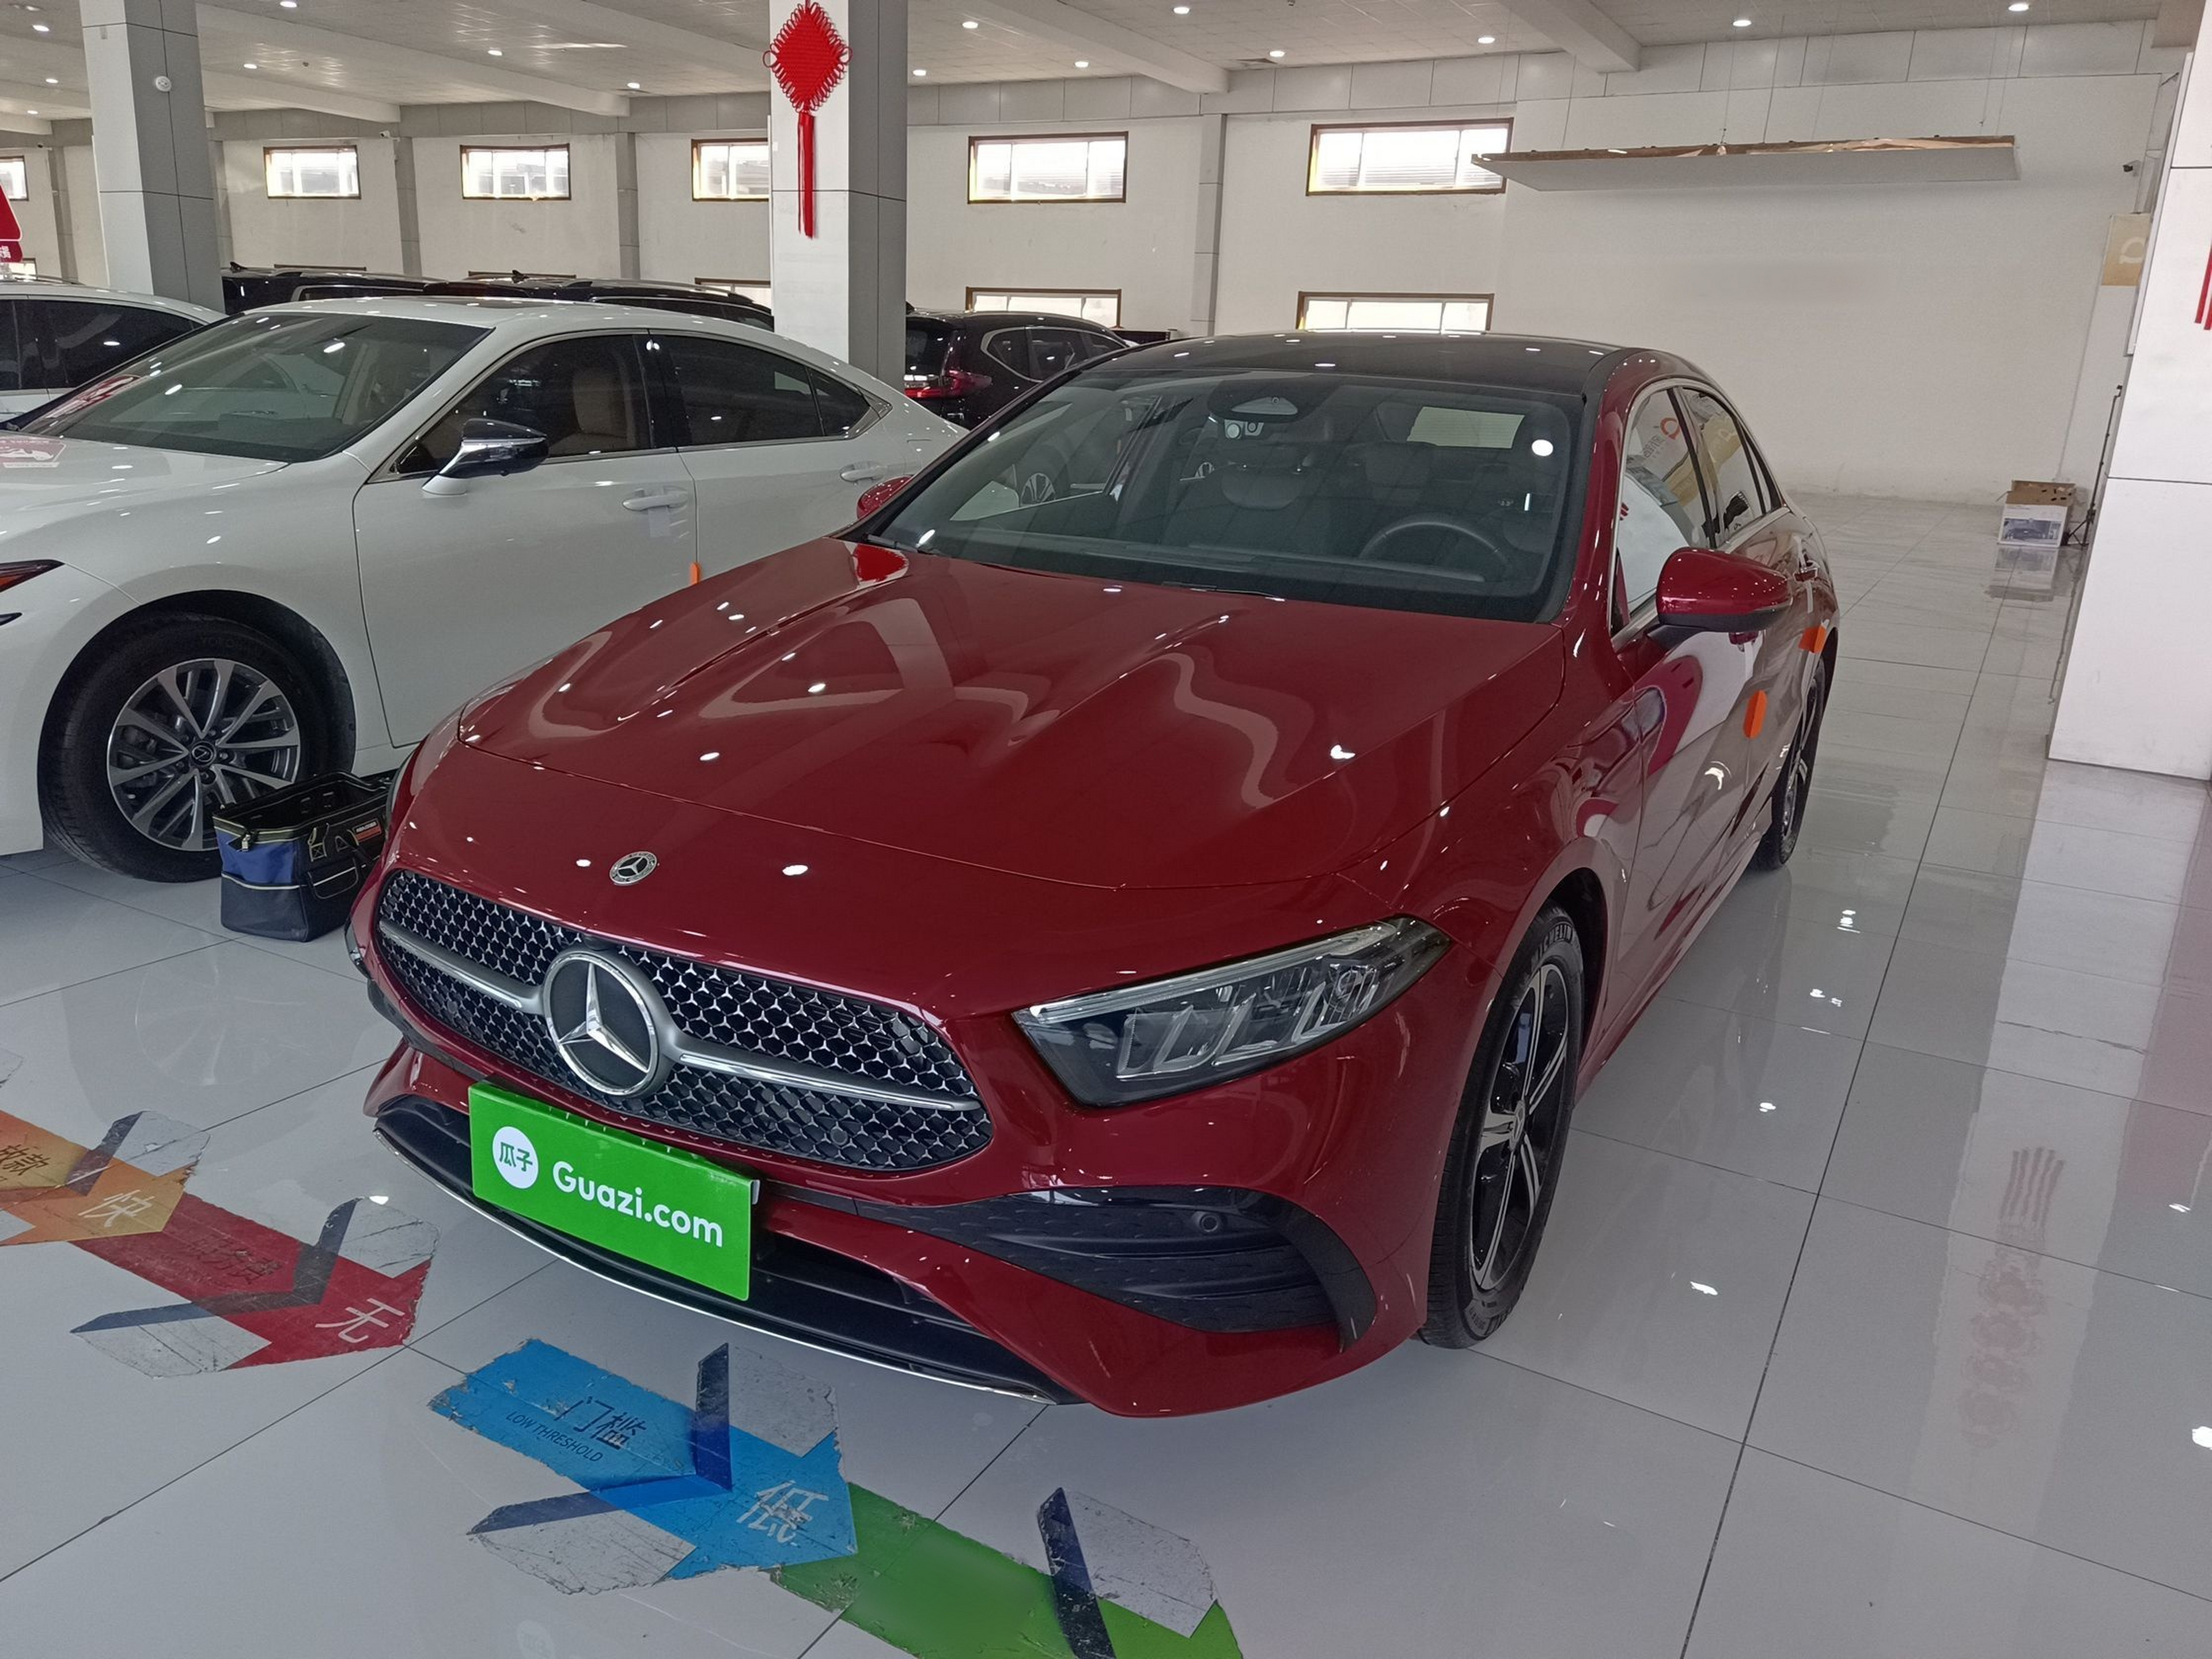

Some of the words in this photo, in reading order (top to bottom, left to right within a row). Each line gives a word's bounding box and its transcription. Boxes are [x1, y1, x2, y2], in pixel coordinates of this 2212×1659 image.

[499, 1141, 533, 1172] 瓜子
[78, 1189, 155, 1228] 快
[552, 1161, 723, 1248] Guazi.com
[315, 1298, 404, 1343] 无
[505, 1410, 537, 1429] LOW
[535, 1422, 604, 1462] THRESHOLD
[554, 1396, 647, 1450] 门槛
